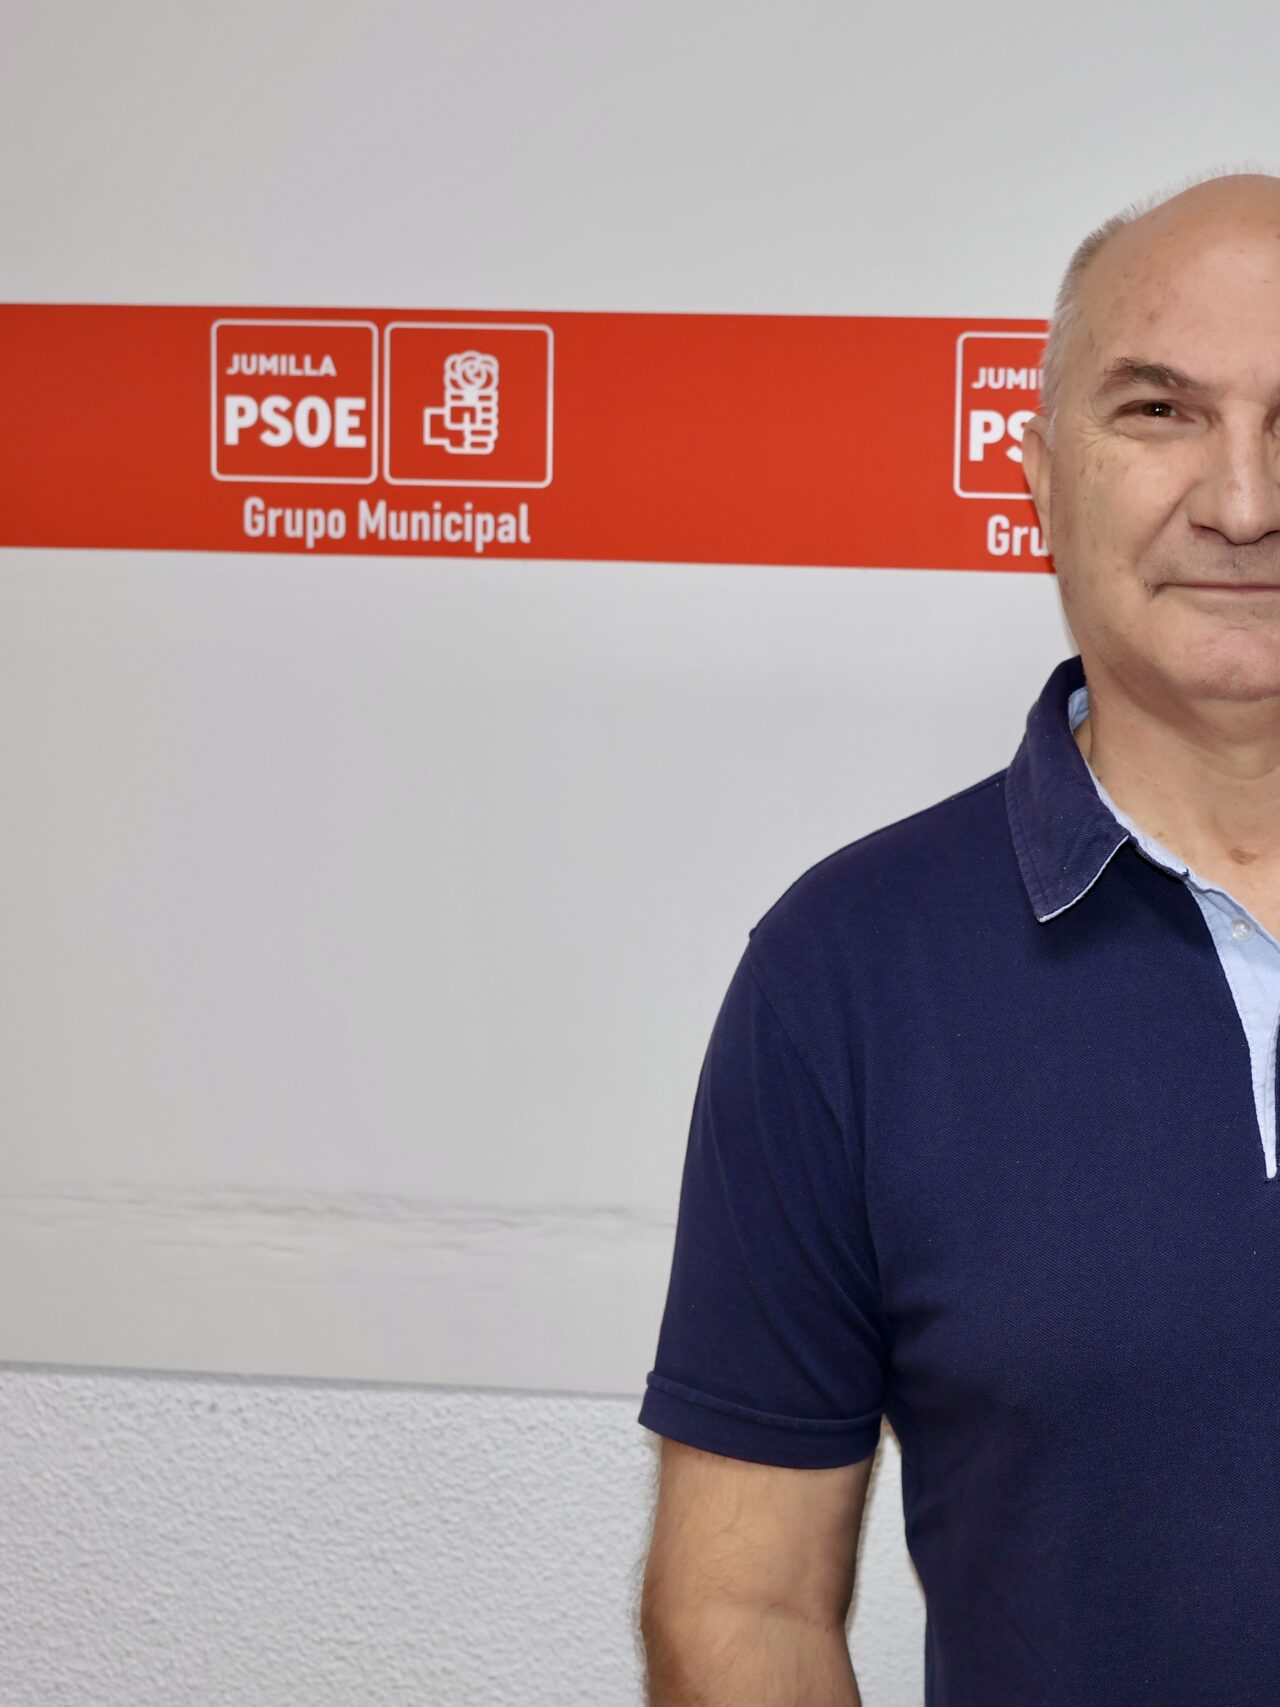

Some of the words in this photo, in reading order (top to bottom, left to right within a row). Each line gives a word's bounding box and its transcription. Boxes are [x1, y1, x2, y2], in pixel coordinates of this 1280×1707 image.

[226, 354, 337, 377] JUMILLA
[224, 395, 367, 448] PSOE
[243, 496, 346, 549] Grupo
[358, 499, 531, 553] Municipal
